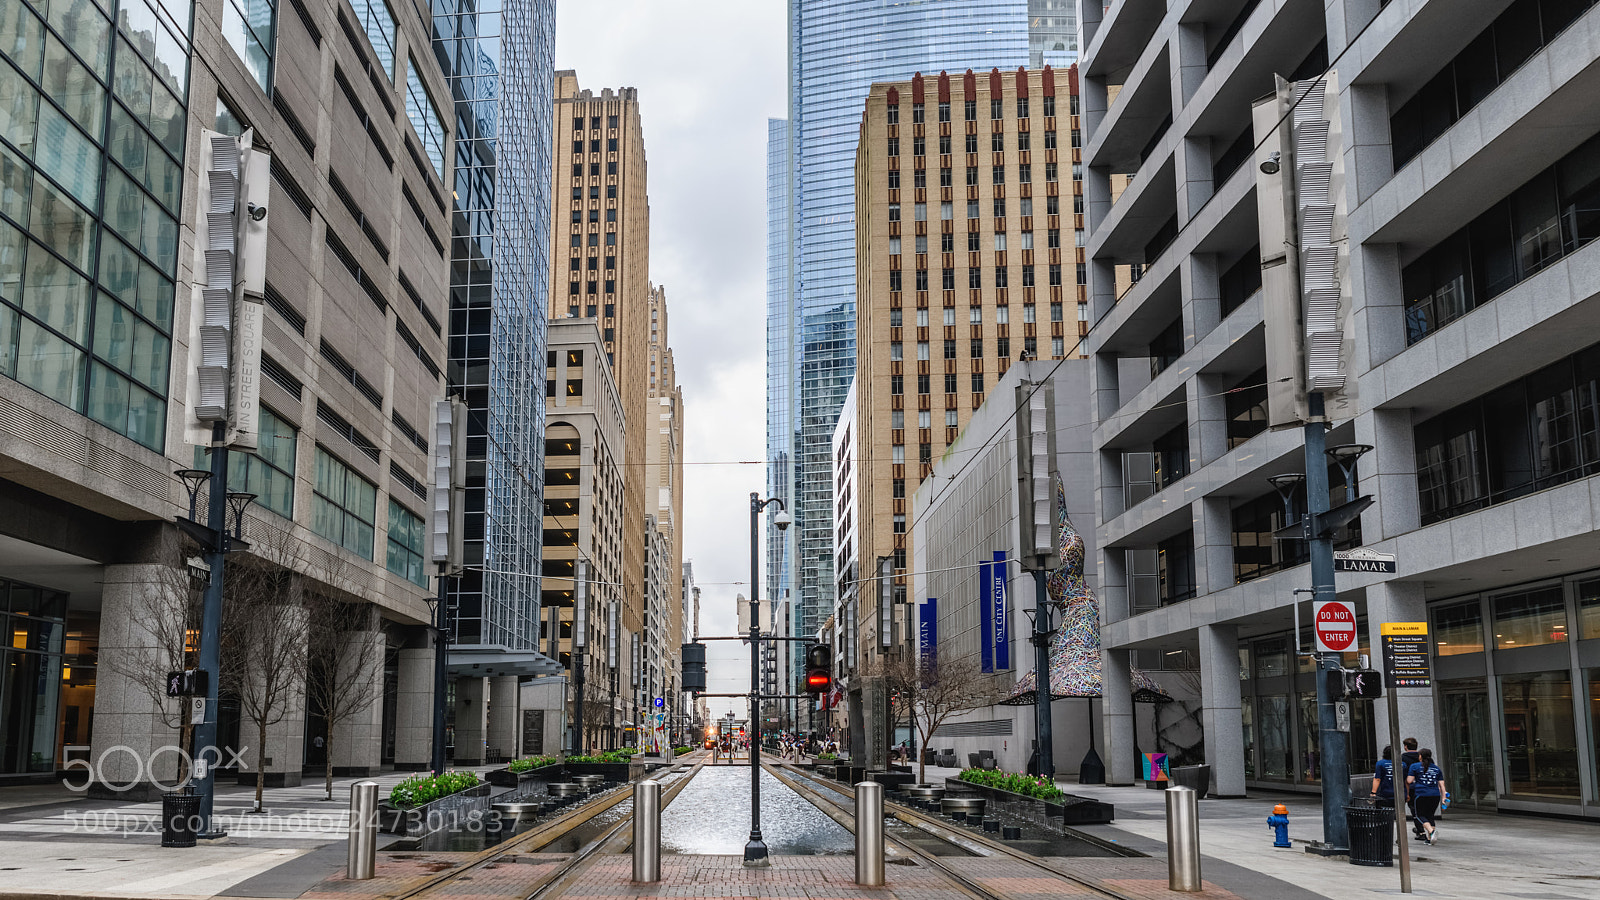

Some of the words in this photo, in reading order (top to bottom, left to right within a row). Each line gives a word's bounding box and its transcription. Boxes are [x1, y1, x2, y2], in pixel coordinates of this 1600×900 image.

[242, 304, 256, 357] SQUARE
[240, 360, 253, 410] STREET
[191, 567, 207, 581] MAIN
[1343, 560, 1388, 572] LAMAR
[995, 607, 1003, 625] CITY
[1320, 611, 1331, 620] DO
[1334, 611, 1349, 620] NOT
[920, 621, 929, 649] MAIN
[995, 626, 1003, 643] ONE
[1325, 633, 1349, 642] ENTER
